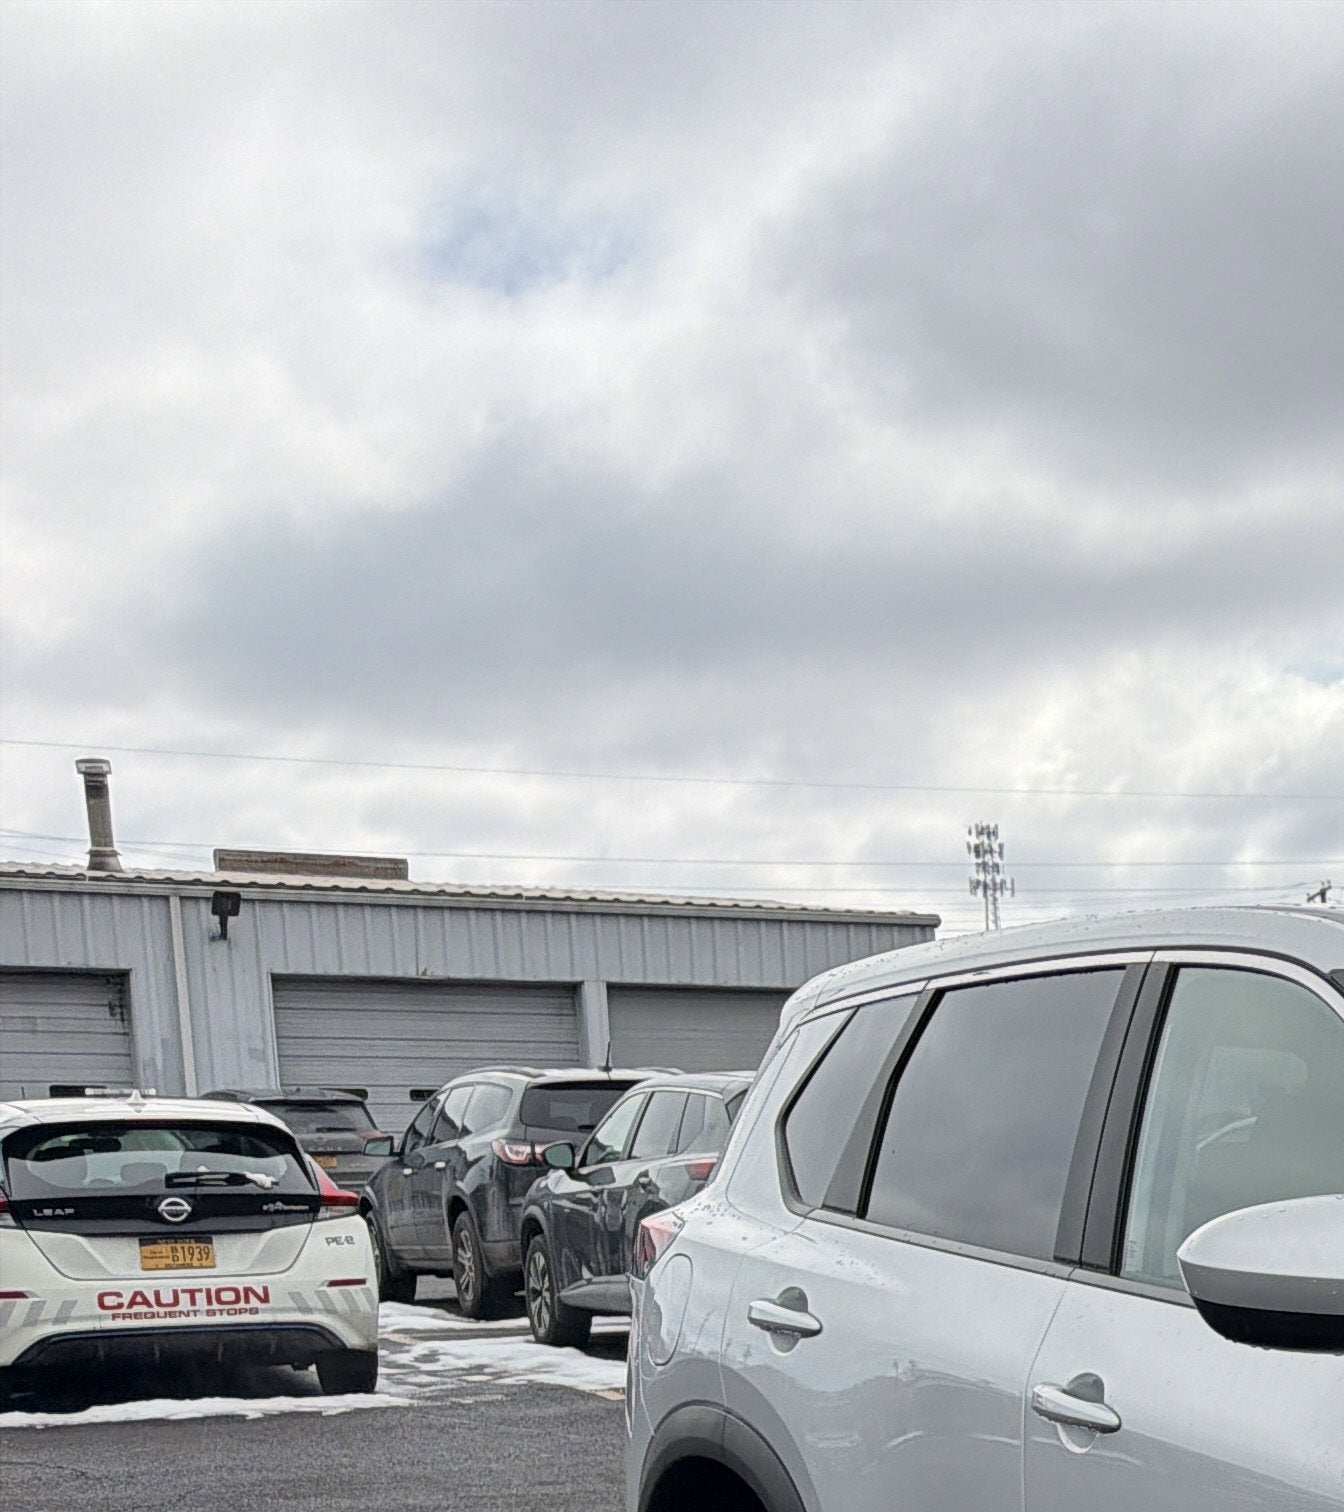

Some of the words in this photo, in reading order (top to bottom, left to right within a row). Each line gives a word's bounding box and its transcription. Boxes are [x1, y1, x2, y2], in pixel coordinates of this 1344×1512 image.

[33, 1208, 75, 1218] LEAF
[97, 1285, 271, 1312] CAUTION
[111, 1310, 200, 1321] FREQUENT
[205, 1307, 260, 1318] STOPS
